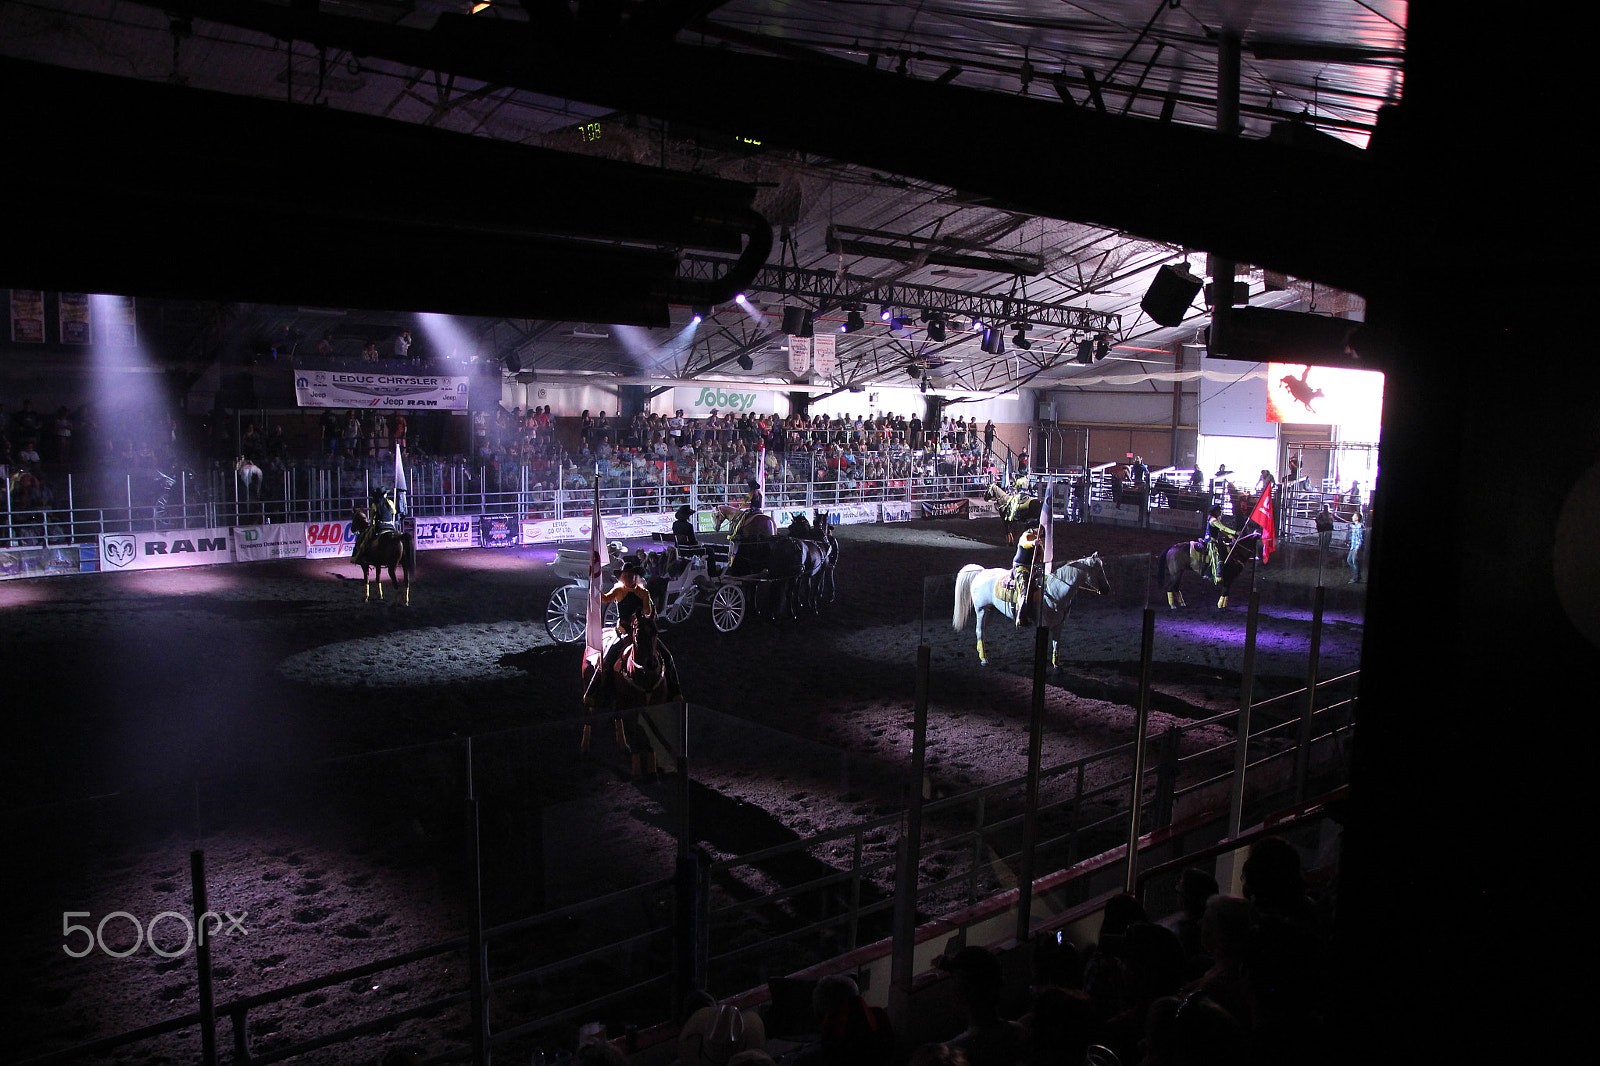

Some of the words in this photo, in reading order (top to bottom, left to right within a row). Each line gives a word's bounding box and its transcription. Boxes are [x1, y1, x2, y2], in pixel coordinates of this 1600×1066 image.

[332, 375, 374, 384] LEDUC
[377, 376, 438, 386] CHRYSLER
[310, 390, 327, 399] Jeep
[443, 394, 456, 402] Jeep
[694, 387, 757, 411] Sobeys
[383, 396, 403, 406] Jeep
[241, 529, 259, 541] TD
[307, 523, 342, 545] 840
[145, 537, 227, 556] RAM
[307, 546, 337, 554] Alberta's
